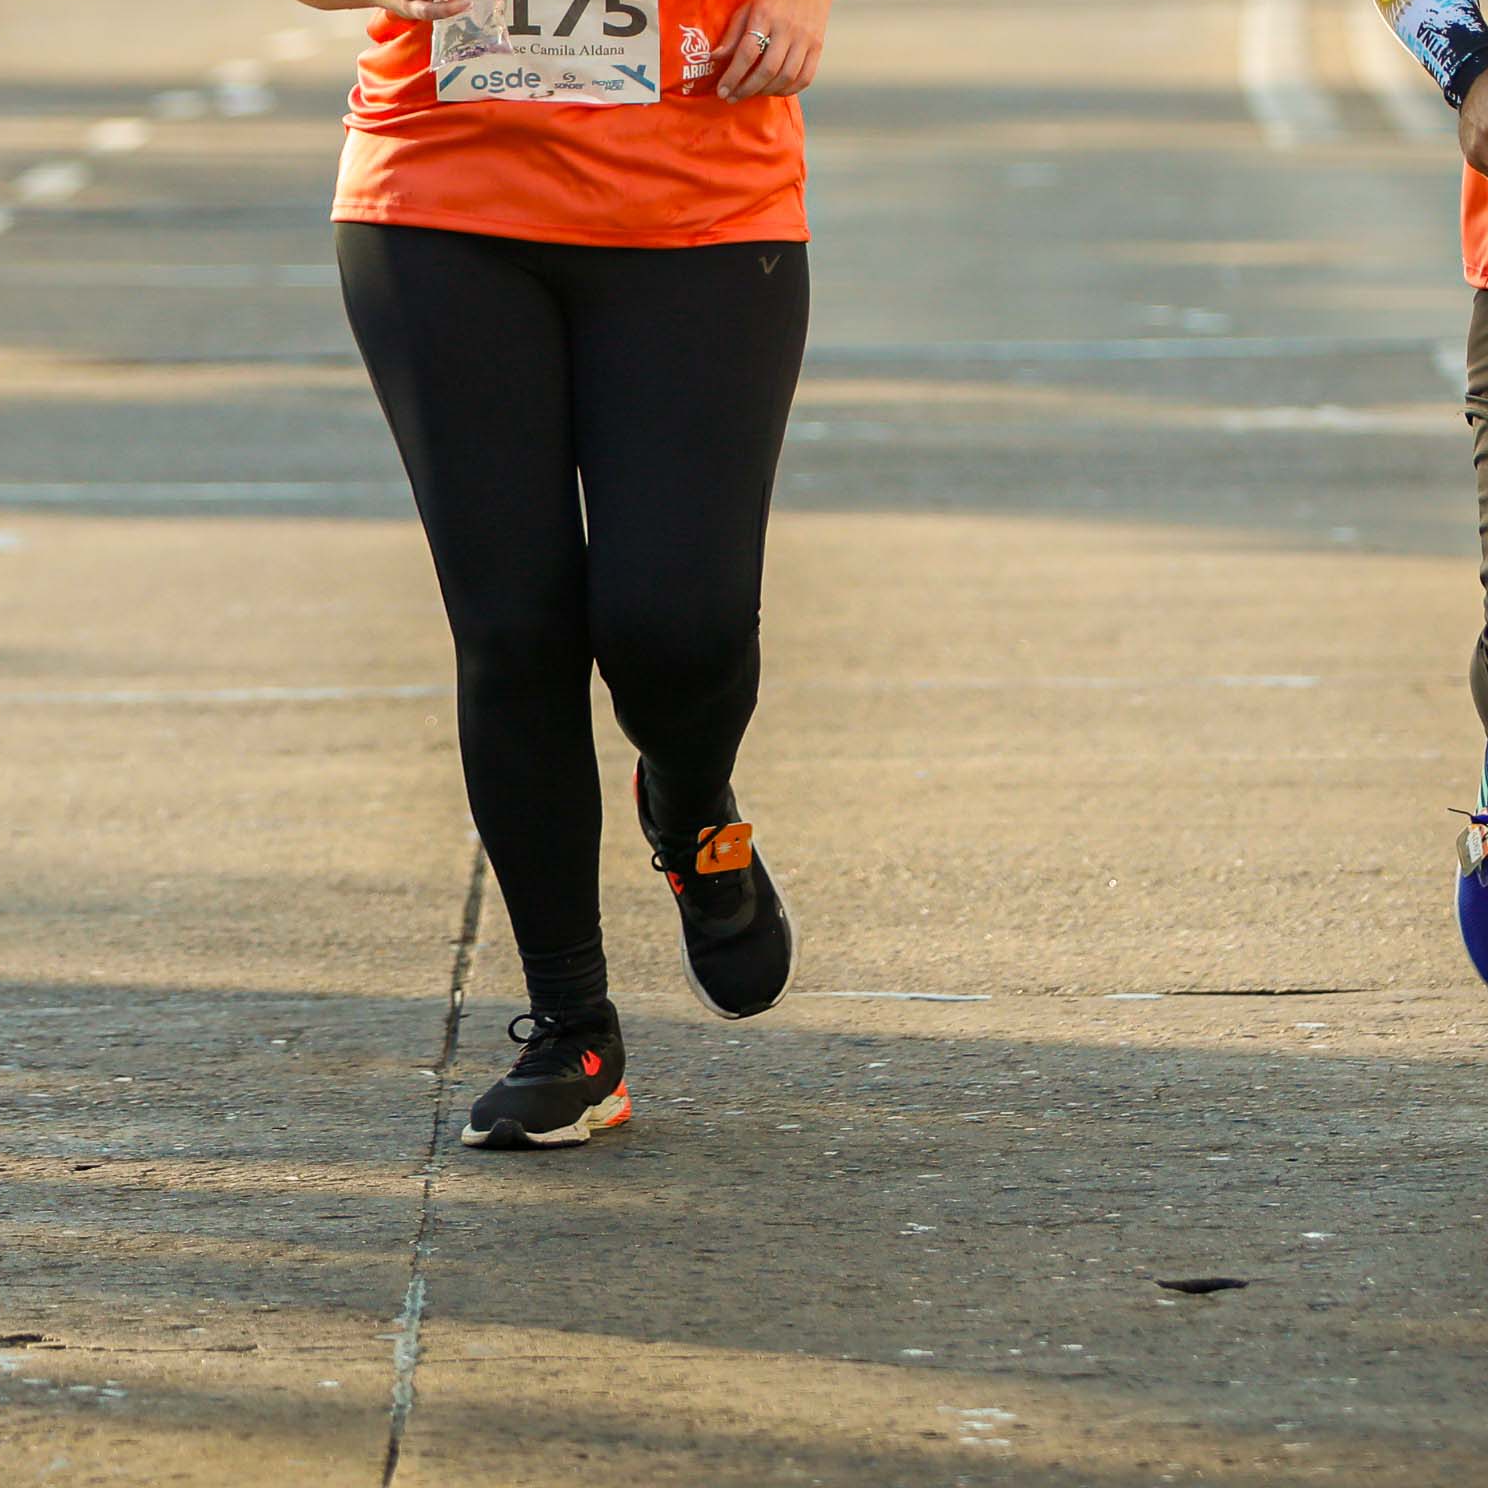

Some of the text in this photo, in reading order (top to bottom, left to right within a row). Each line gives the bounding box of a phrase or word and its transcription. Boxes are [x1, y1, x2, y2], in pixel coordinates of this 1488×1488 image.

[530, 43, 575, 56] Camila
[579, 43, 625, 56] Aldana
[471, 66, 541, 93] osde
